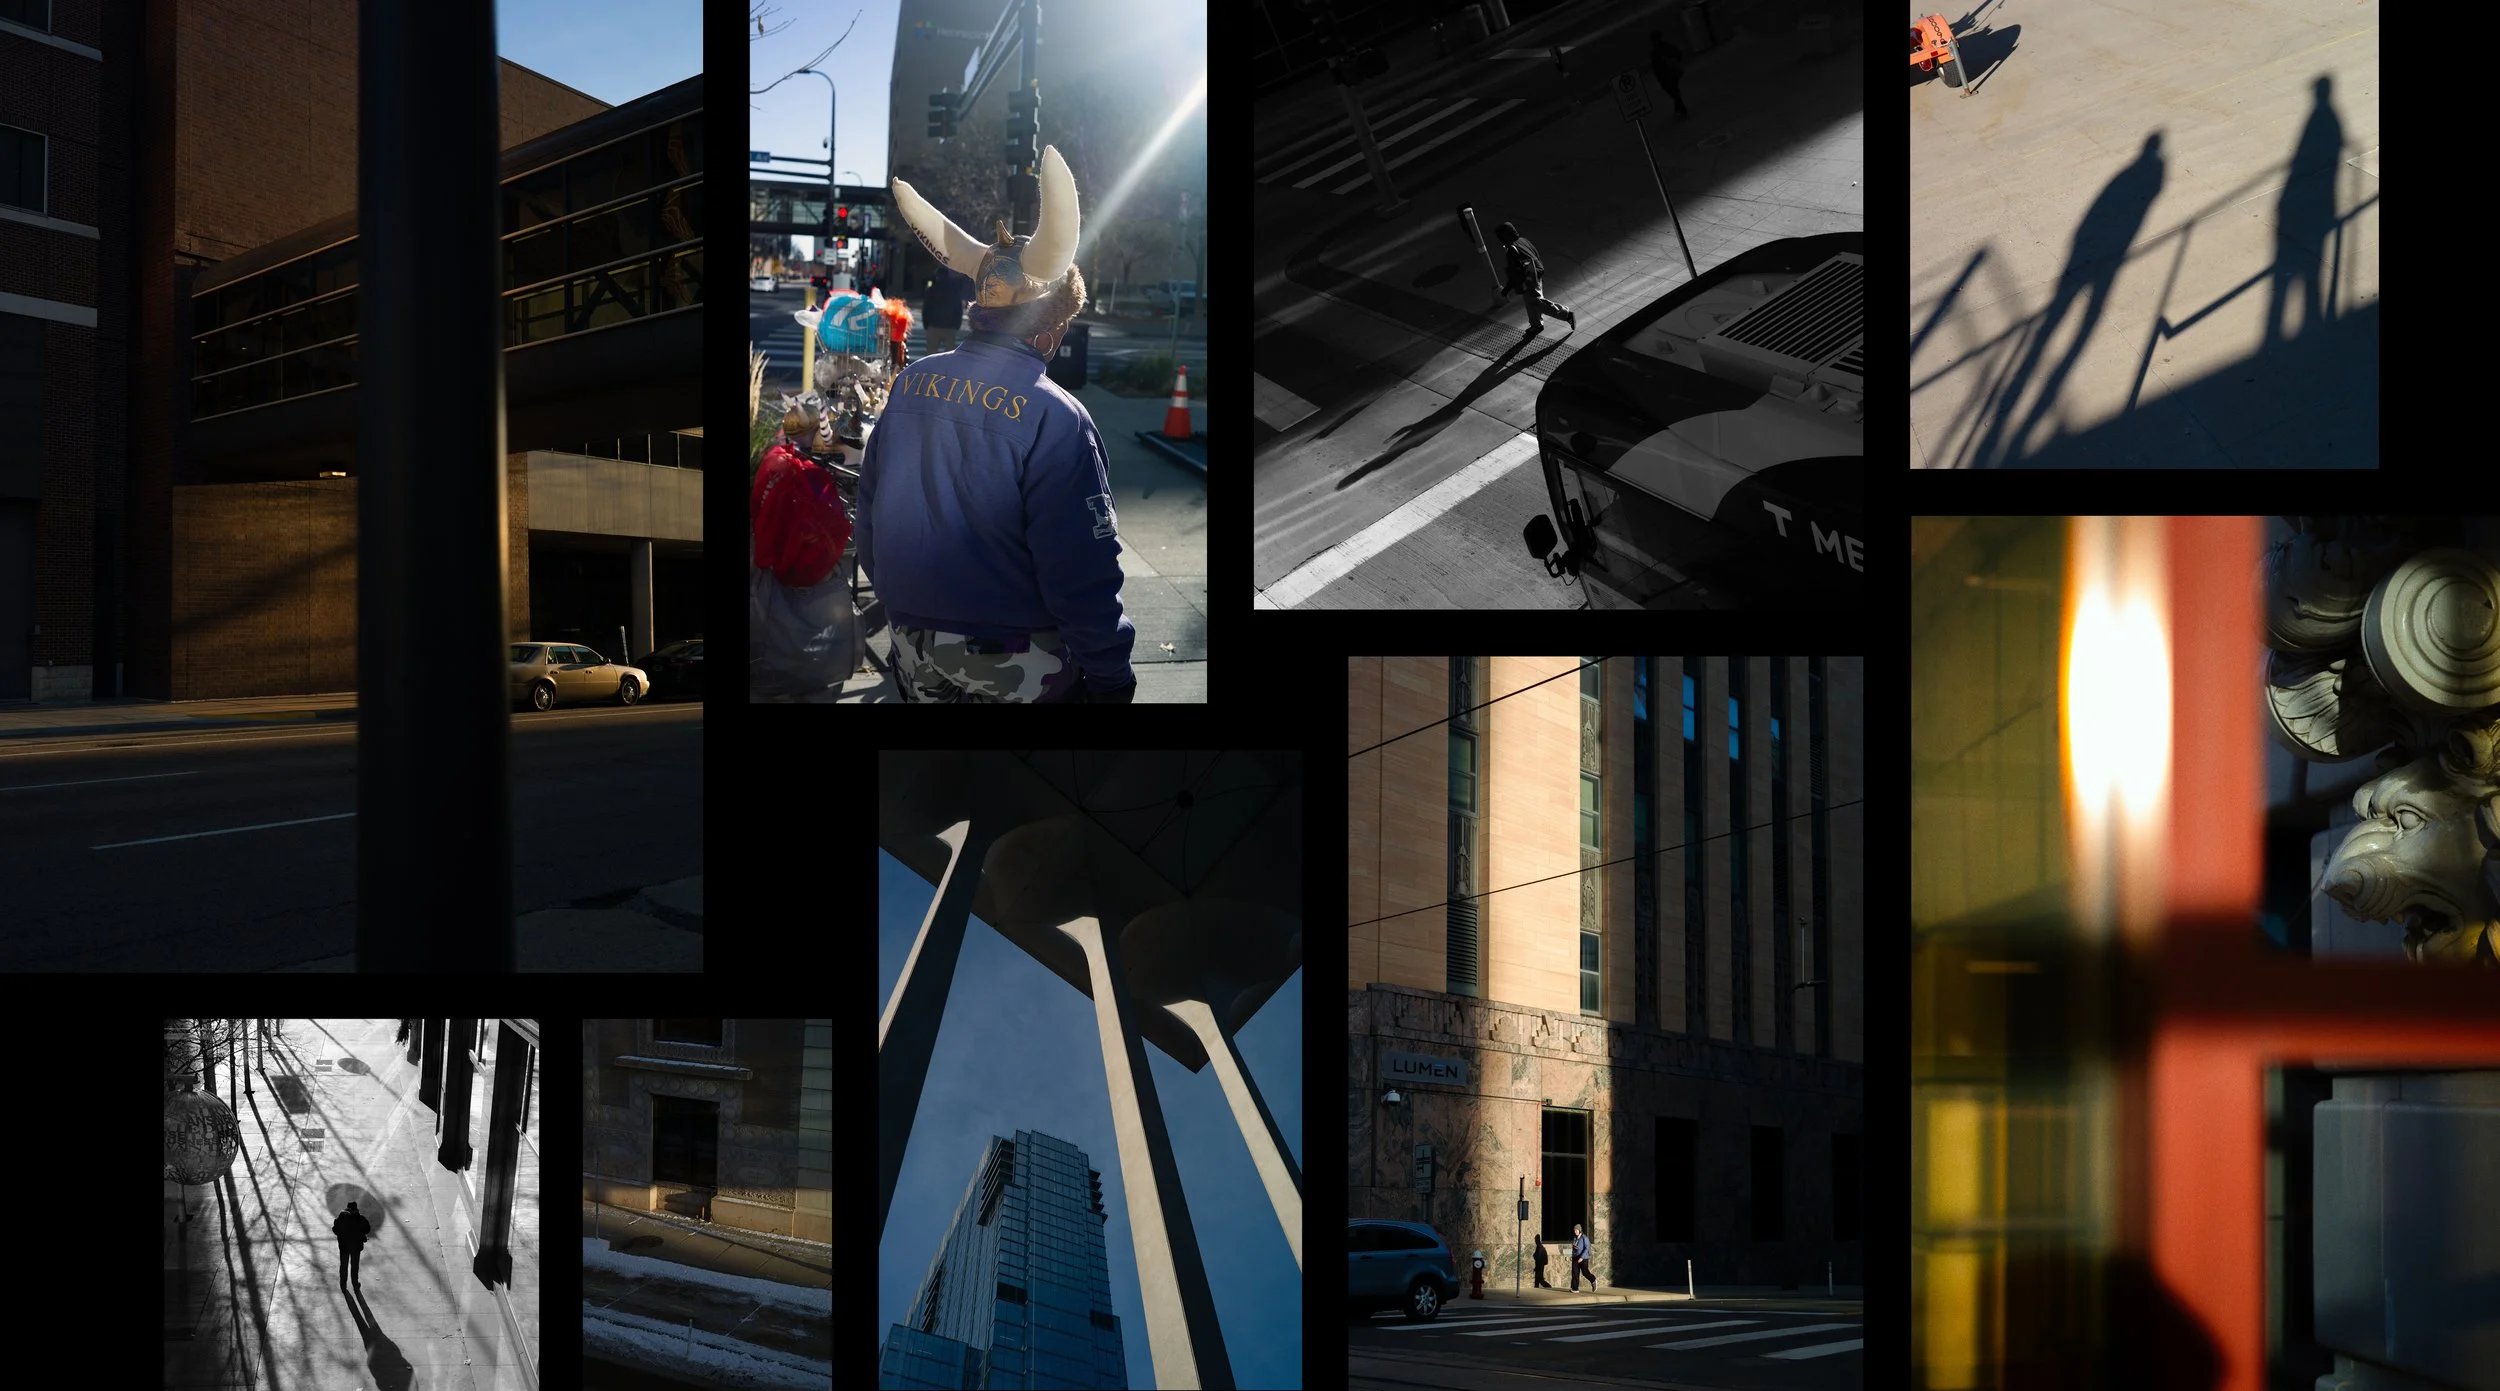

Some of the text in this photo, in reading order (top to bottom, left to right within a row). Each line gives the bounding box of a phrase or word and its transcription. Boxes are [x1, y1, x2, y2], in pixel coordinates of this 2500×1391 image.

[911, 223, 950, 265] VIKINGS
[903, 372, 1028, 420] VIKINGS
[1762, 499, 1864, 573] T ME
[1393, 1058, 1459, 1079] LUMEN
